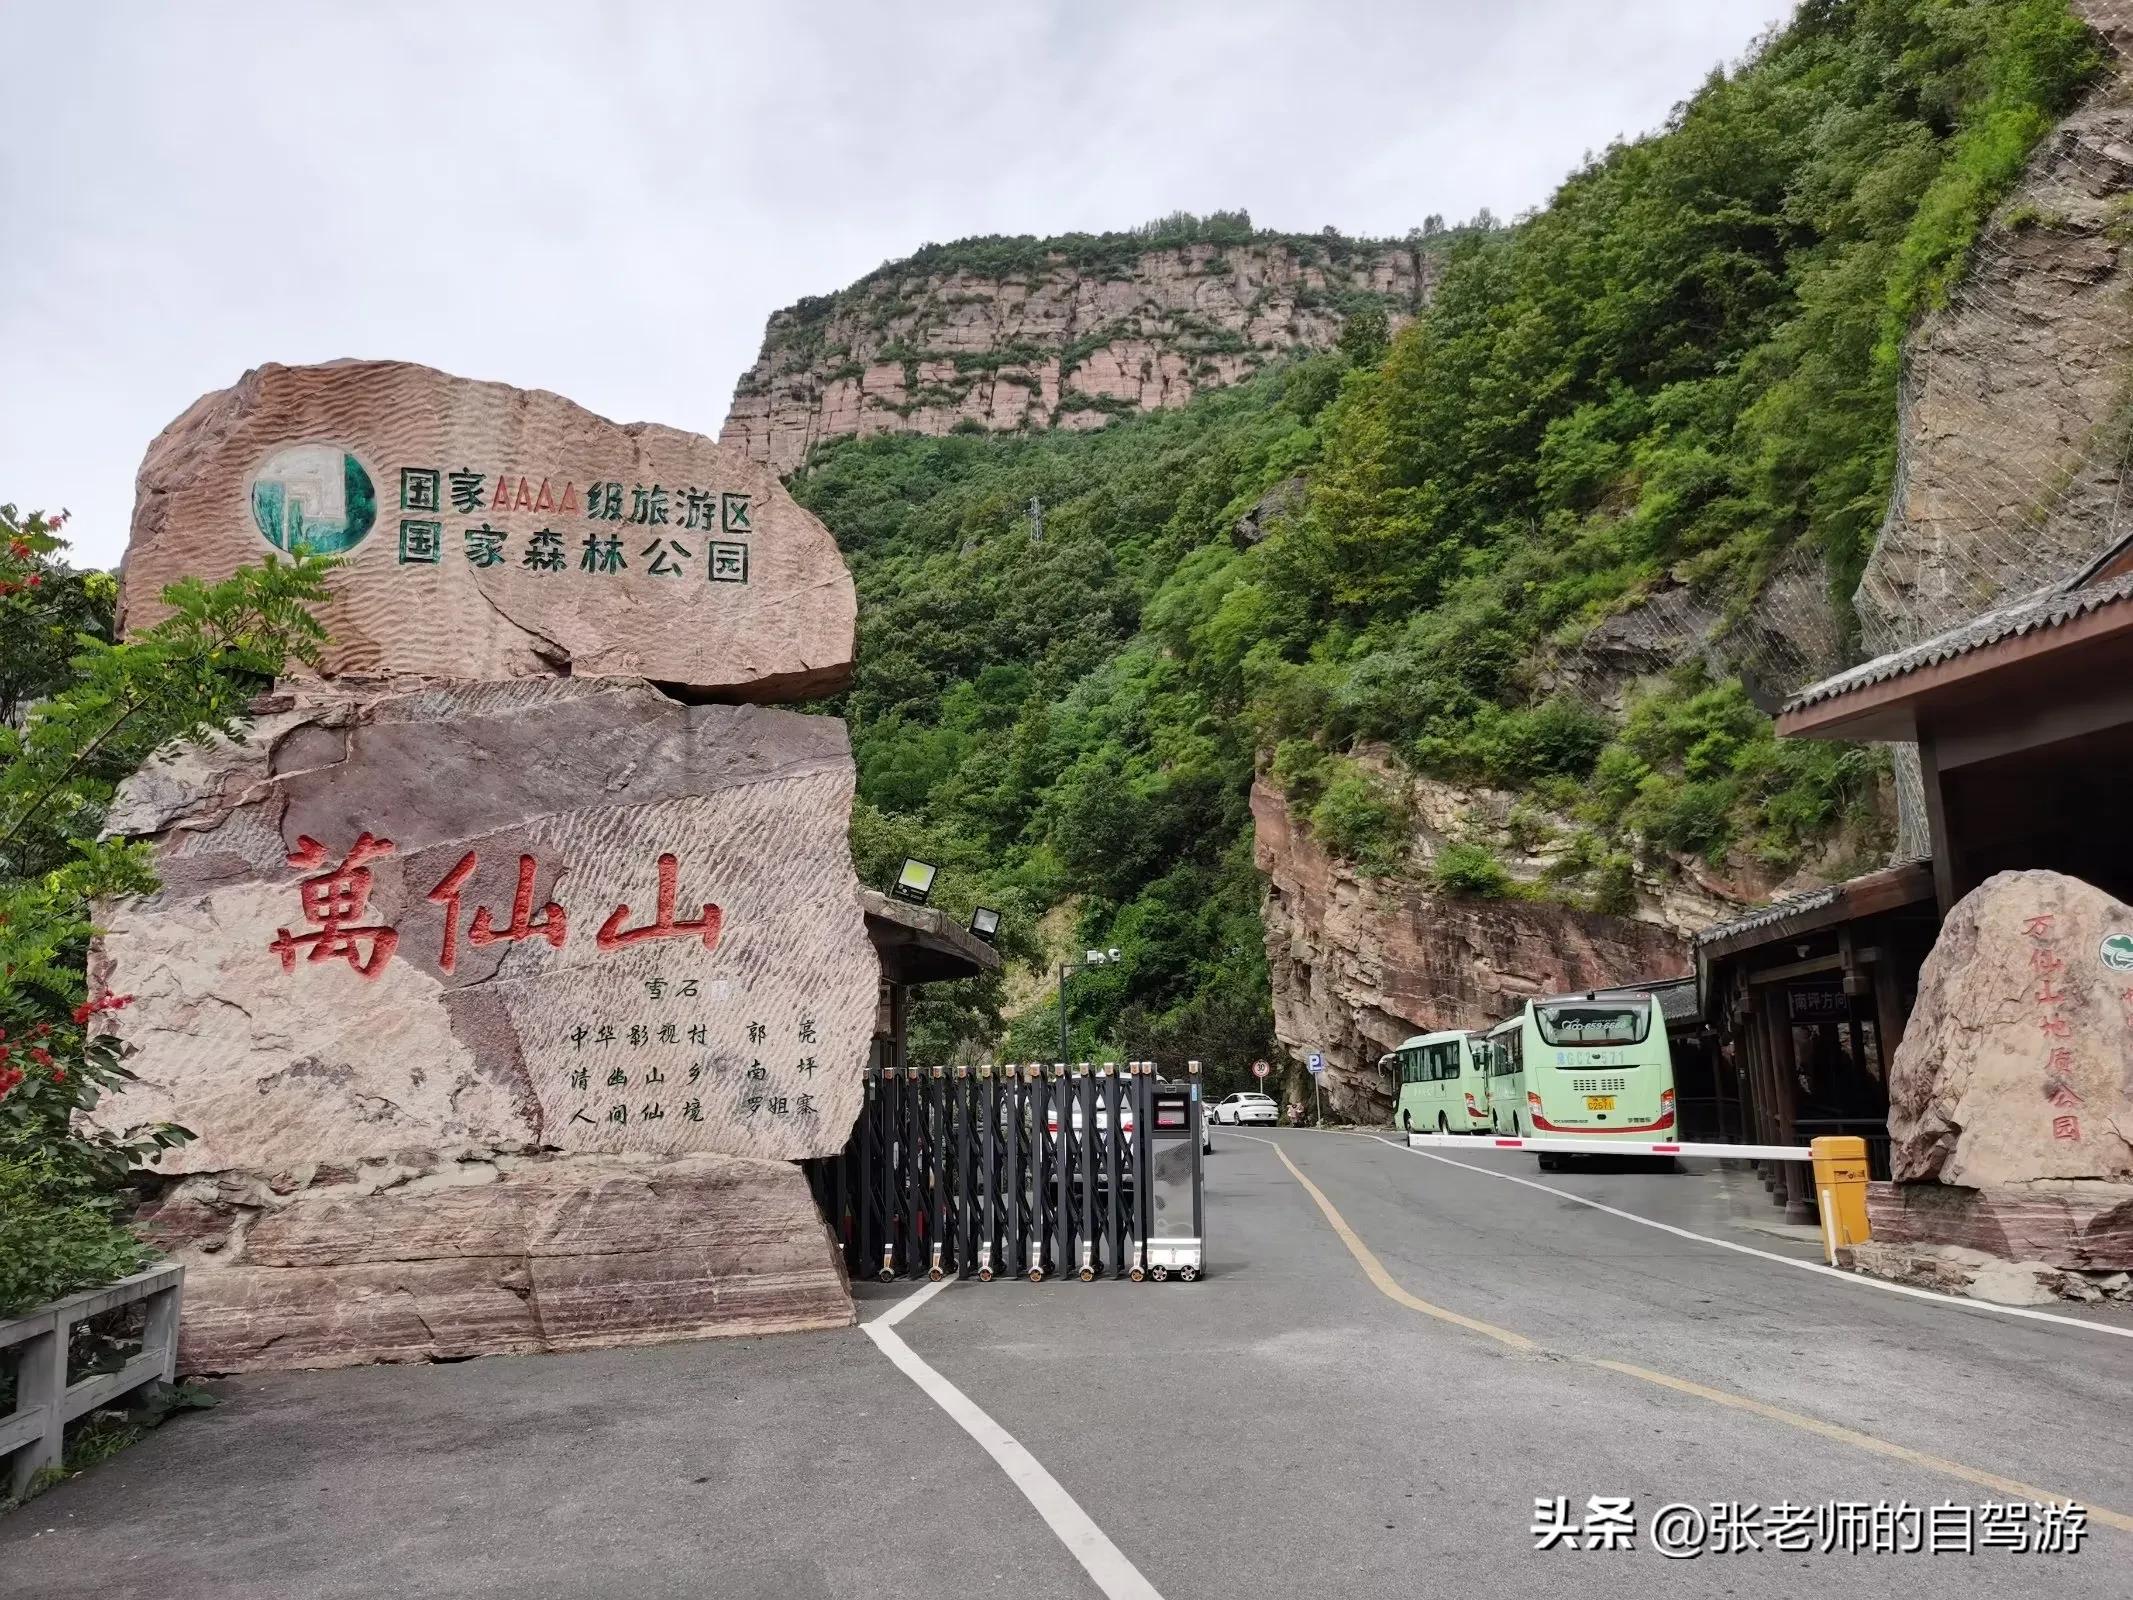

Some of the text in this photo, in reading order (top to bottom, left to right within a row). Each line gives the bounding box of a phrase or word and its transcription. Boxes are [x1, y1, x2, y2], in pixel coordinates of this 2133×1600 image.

[401, 467, 752, 533] 国家AAAA级旅游区
[400, 519, 749, 584] 国家森林公园
[269, 831, 723, 981] 萬仙山
[645, 978, 699, 1000] 雪石
[570, 1020, 817, 1050] 中华影视村 郭亮
[2021, 915, 2085, 1141] 万仙山地质公园
[571, 1056, 818, 1091] 清幽山乡 南坪
[1309, 1055, 1319, 1070] P
[568, 1098, 704, 1125] 人间仙境
